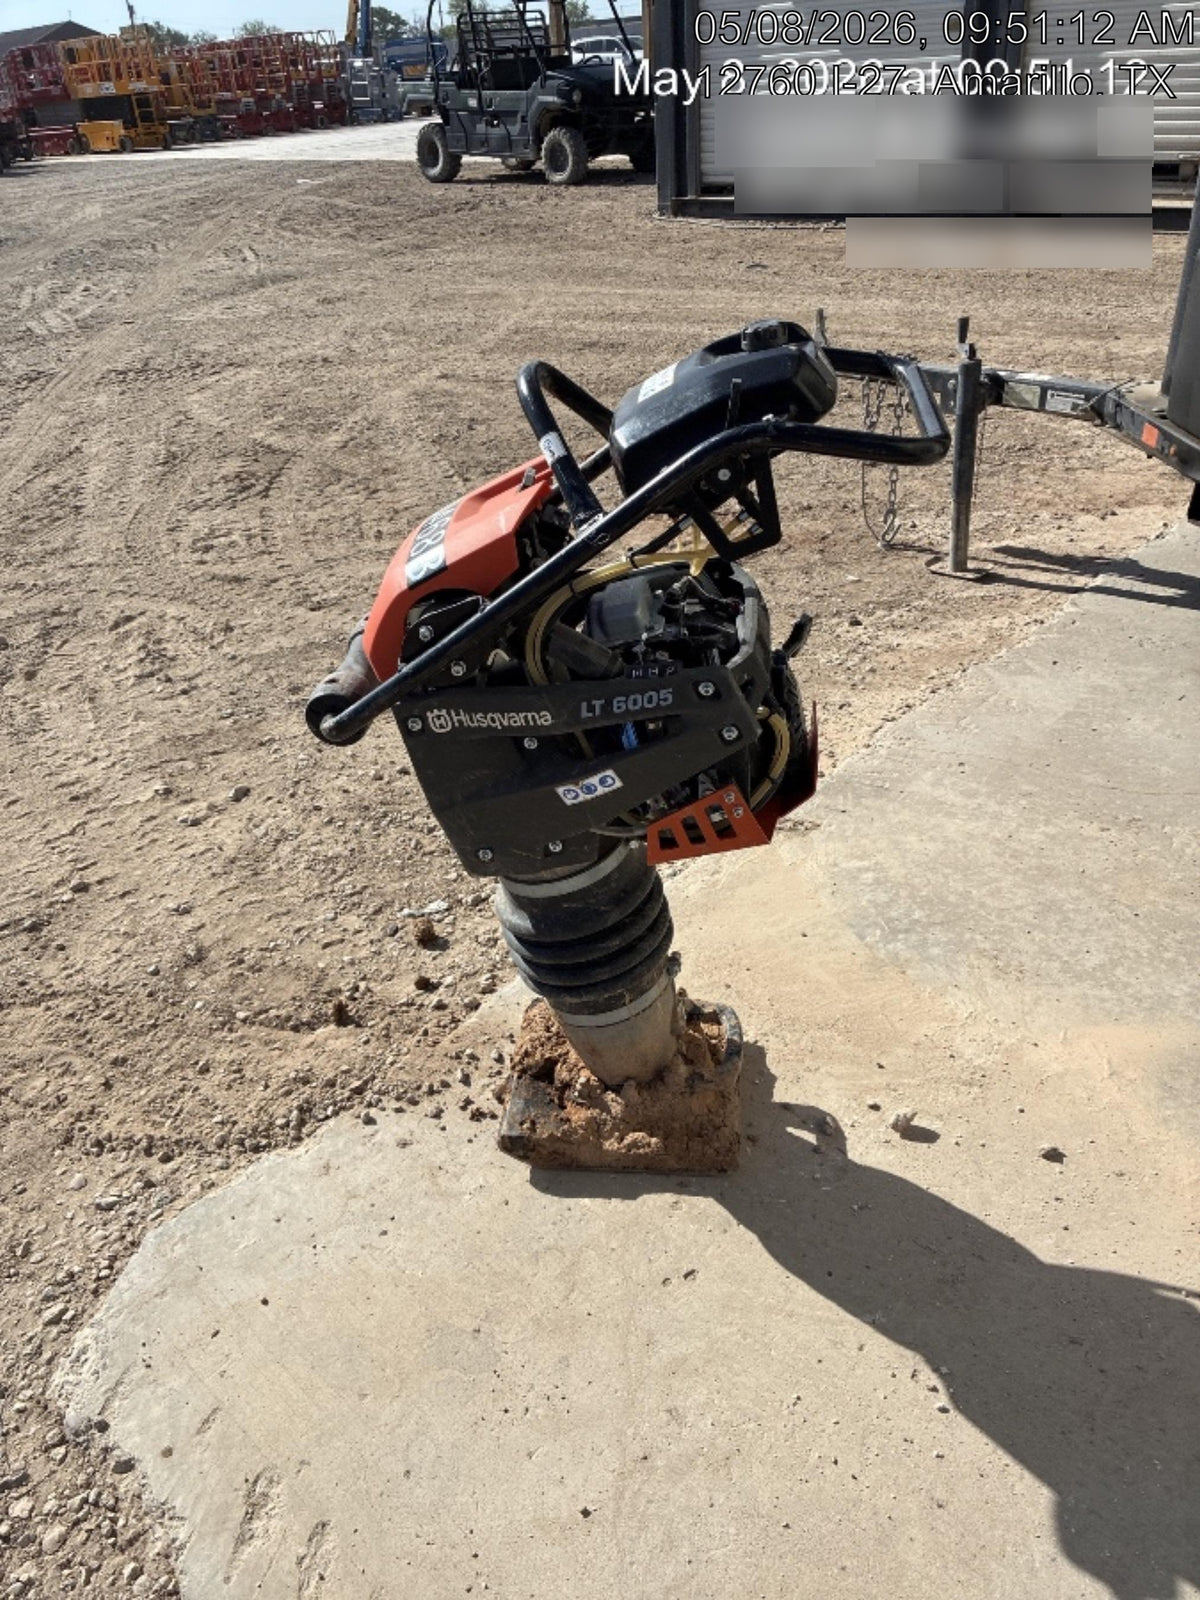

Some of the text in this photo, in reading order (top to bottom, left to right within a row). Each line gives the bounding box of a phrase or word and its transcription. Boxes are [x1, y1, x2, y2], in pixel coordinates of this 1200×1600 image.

[580, 687, 673, 719] LT 6005
[450, 708, 552, 730] Husqvarna
